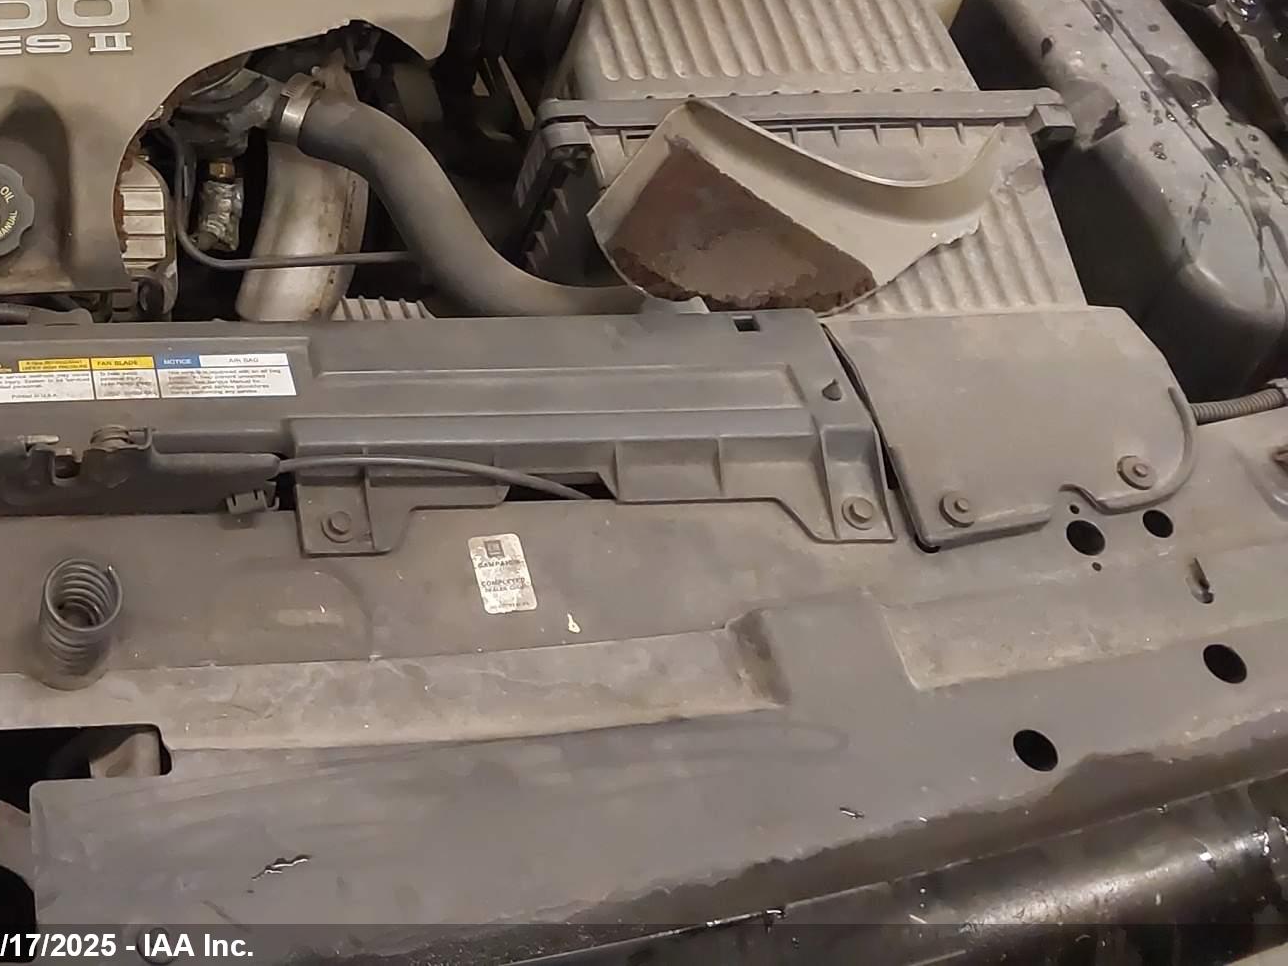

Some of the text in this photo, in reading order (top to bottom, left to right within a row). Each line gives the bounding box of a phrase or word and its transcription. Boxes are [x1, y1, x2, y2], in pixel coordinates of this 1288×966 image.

[88, 32, 133, 53] II
[0, 186, 15, 204] OIL
[481, 577, 526, 587] COMPLETED
